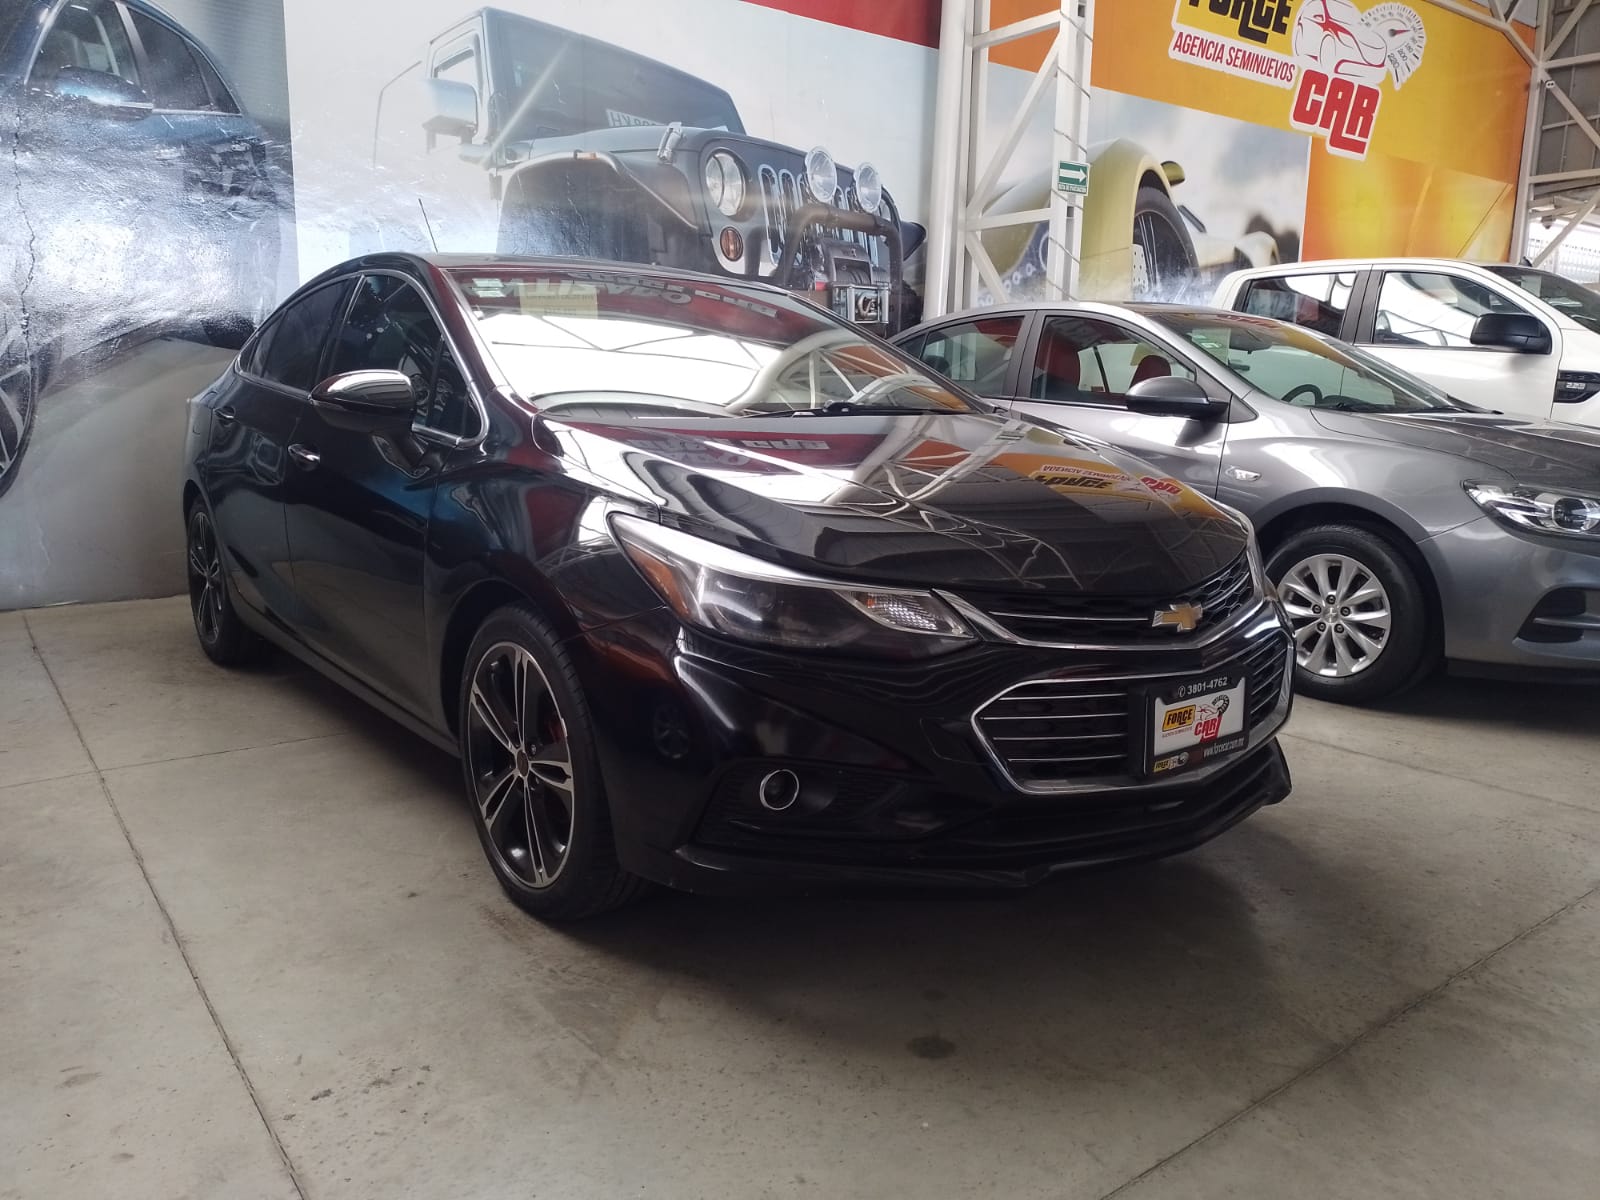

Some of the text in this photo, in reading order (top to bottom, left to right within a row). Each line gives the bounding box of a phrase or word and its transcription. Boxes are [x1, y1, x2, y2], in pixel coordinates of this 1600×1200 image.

[1172, 31, 1296, 82] AGENCIA SEMINUEVOS
[1293, 69, 1380, 154] CAR
[1187, 677, 1228, 694] 3801-4762
[1167, 709, 1193, 725] FORCE
[1194, 718, 1218, 737] CAR
